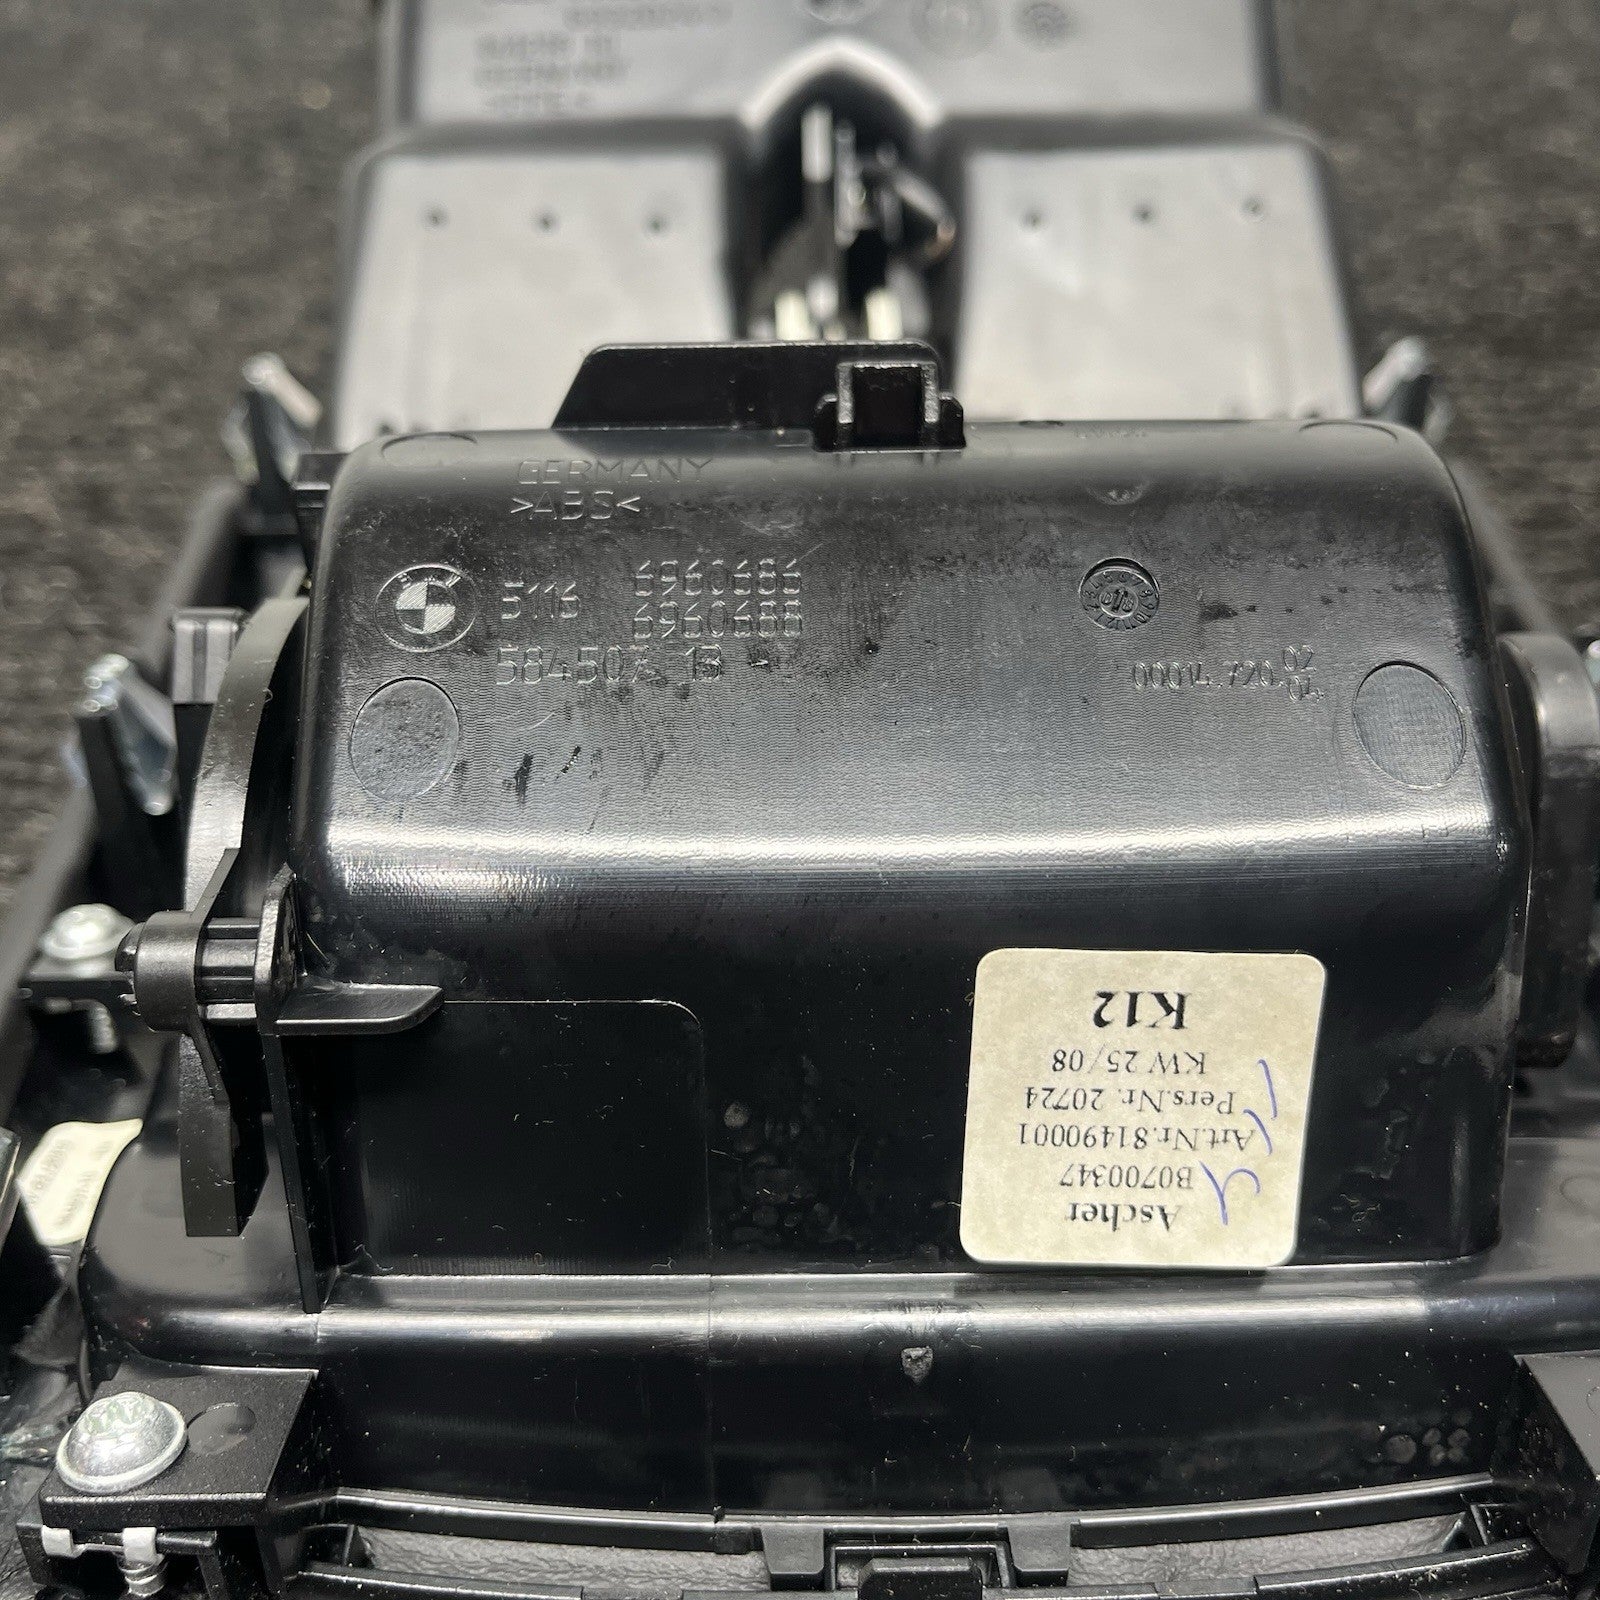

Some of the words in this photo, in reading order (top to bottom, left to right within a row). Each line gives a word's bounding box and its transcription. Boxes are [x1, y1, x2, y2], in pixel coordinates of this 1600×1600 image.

[517, 458, 713, 485] GERMANY
[501, 581, 580, 621] 5116
[633, 558, 802, 598] 6960686
[632, 599, 803, 639] 6960688
[1092, 990, 1192, 1031] K12
[1051, 1045, 1141, 1074] 25/08
[1150, 1051, 1208, 1075] KW
[1024, 1086, 1105, 1112] 20724
[1117, 1088, 1237, 1116] Pers.Nr.
[1017, 1122, 1258, 1152] Art.Nr.81490001
[1059, 1162, 1195, 1190] B0700347
[1067, 1200, 1184, 1233] Ascher
